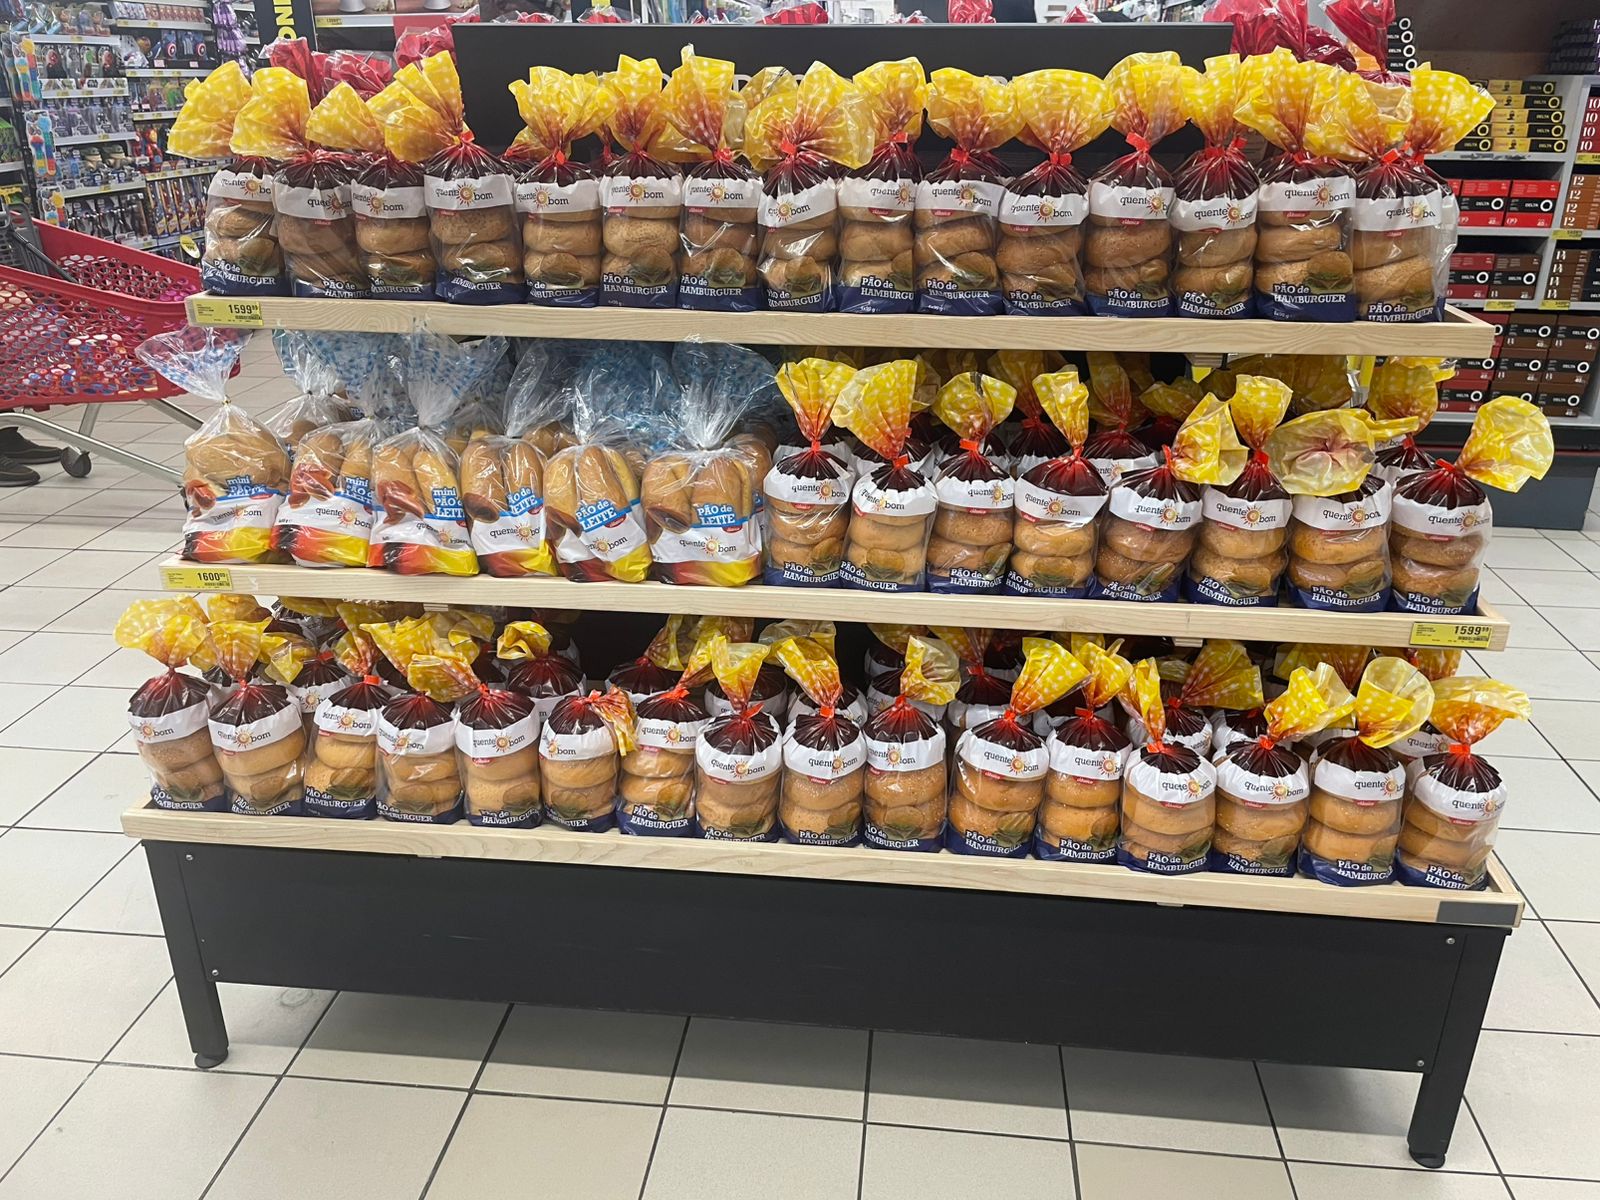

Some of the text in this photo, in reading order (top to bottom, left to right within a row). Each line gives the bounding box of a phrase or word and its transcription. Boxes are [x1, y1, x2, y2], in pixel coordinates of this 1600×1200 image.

[1572, 177, 1584, 186] 12
[1569, 190, 1581, 199] 12
[1120, 196, 1149, 206] quent
[1566, 204, 1577, 213] 12
[1563, 217, 1575, 226] 12
[699, 278, 708, 286] de
[861, 287, 914, 300] HAMBURGU
[1298, 286, 1309, 294] de
[1204, 299, 1216, 308] de
[229, 305, 252, 314] 1599
[346, 477, 368, 485] mini
[598, 500, 609, 509] de
[437, 507, 464, 517] LEIT
[581, 507, 616, 529] LEITE
[700, 515, 736, 525] LEITE
[783, 570, 840, 583] HAMBURGUE
[856, 569, 865, 577] de
[1024, 579, 1034, 587] de
[1336, 590, 1347, 598] de
[1432, 597, 1444, 606] de
[1455, 626, 1481, 635] 1599
[808, 759, 832, 767] quent
[1451, 873, 1464, 882] de
